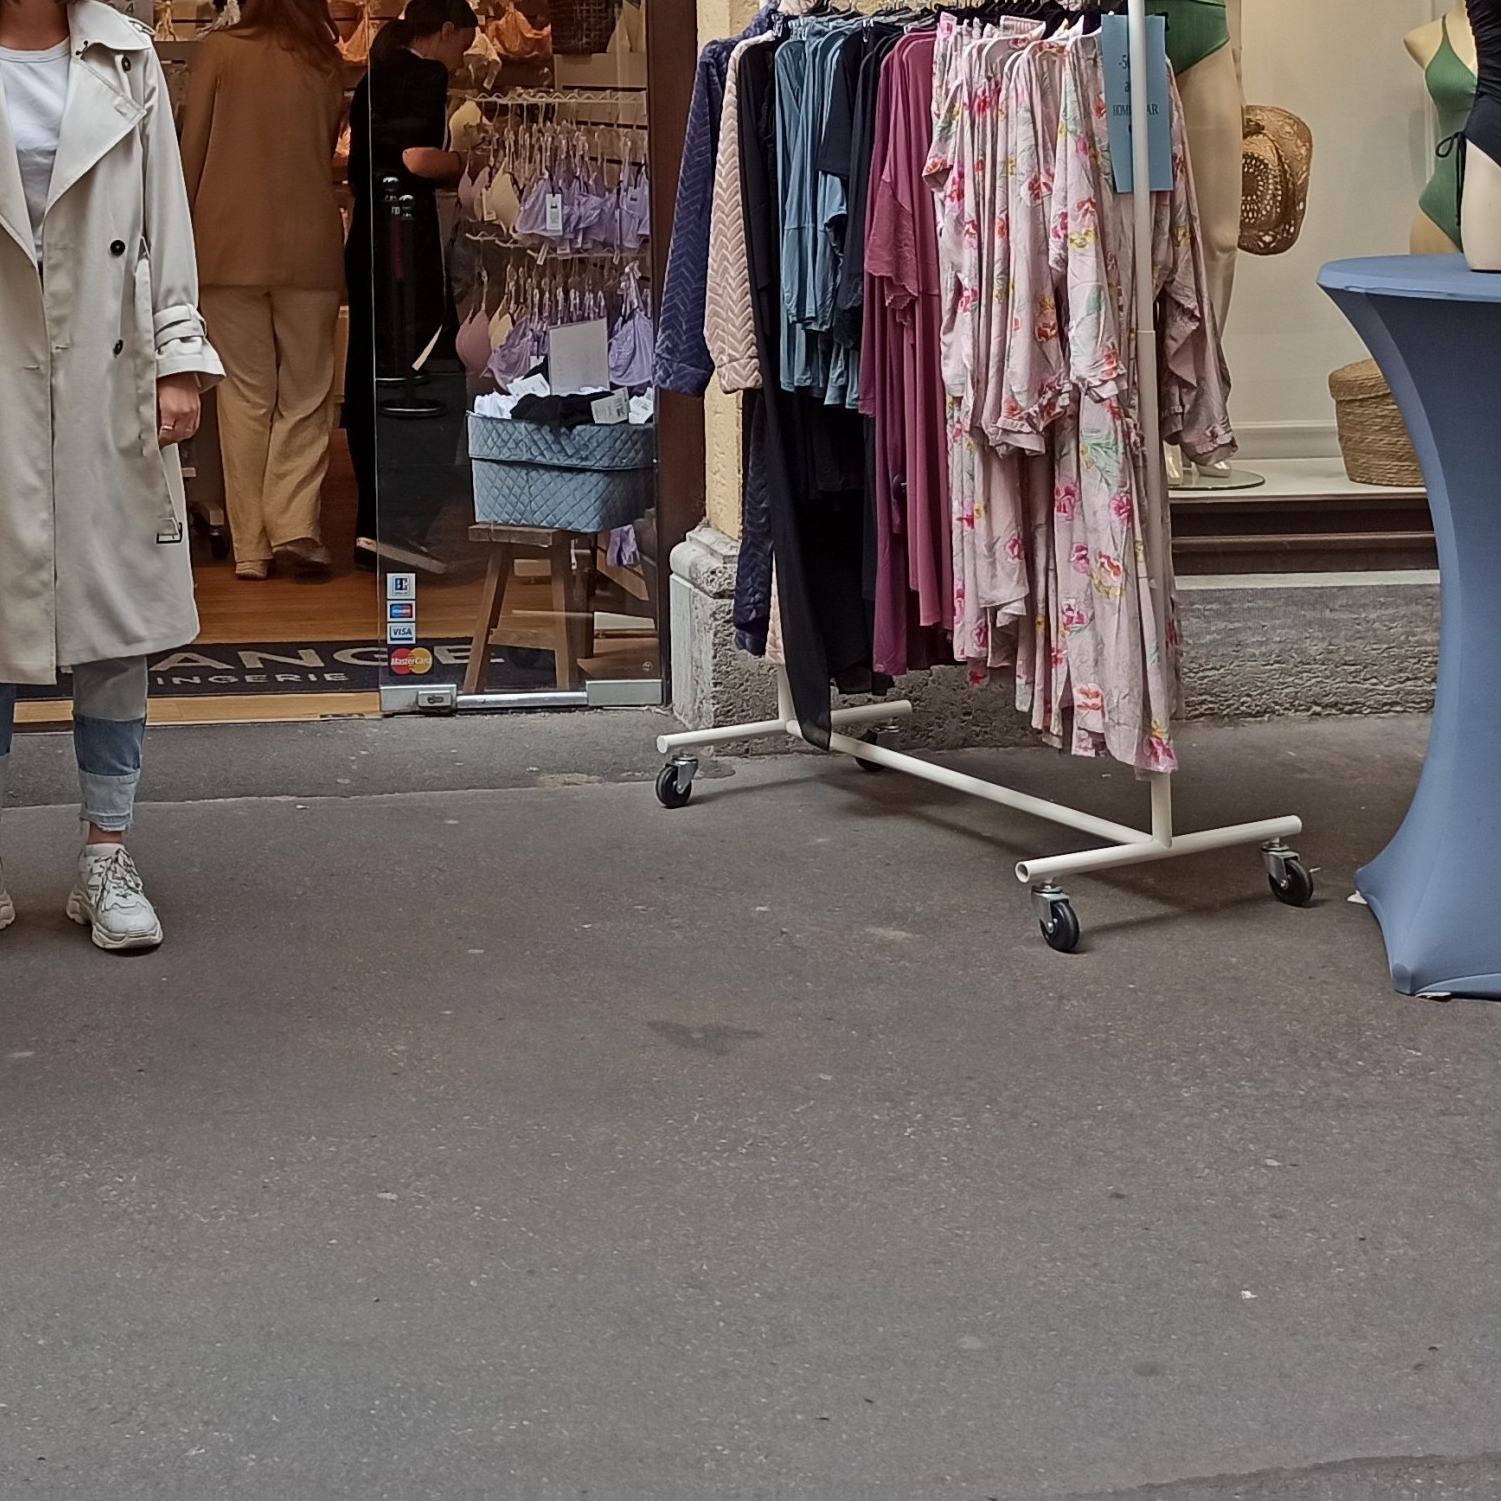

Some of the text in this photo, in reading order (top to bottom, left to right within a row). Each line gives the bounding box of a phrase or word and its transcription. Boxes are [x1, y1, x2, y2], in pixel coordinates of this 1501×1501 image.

[1118, 54, 1130, 70] -5
[392, 627, 413, 636] VISA
[390, 656, 432, 667] MasterCard
[157, 672, 350, 686] INGERIE
